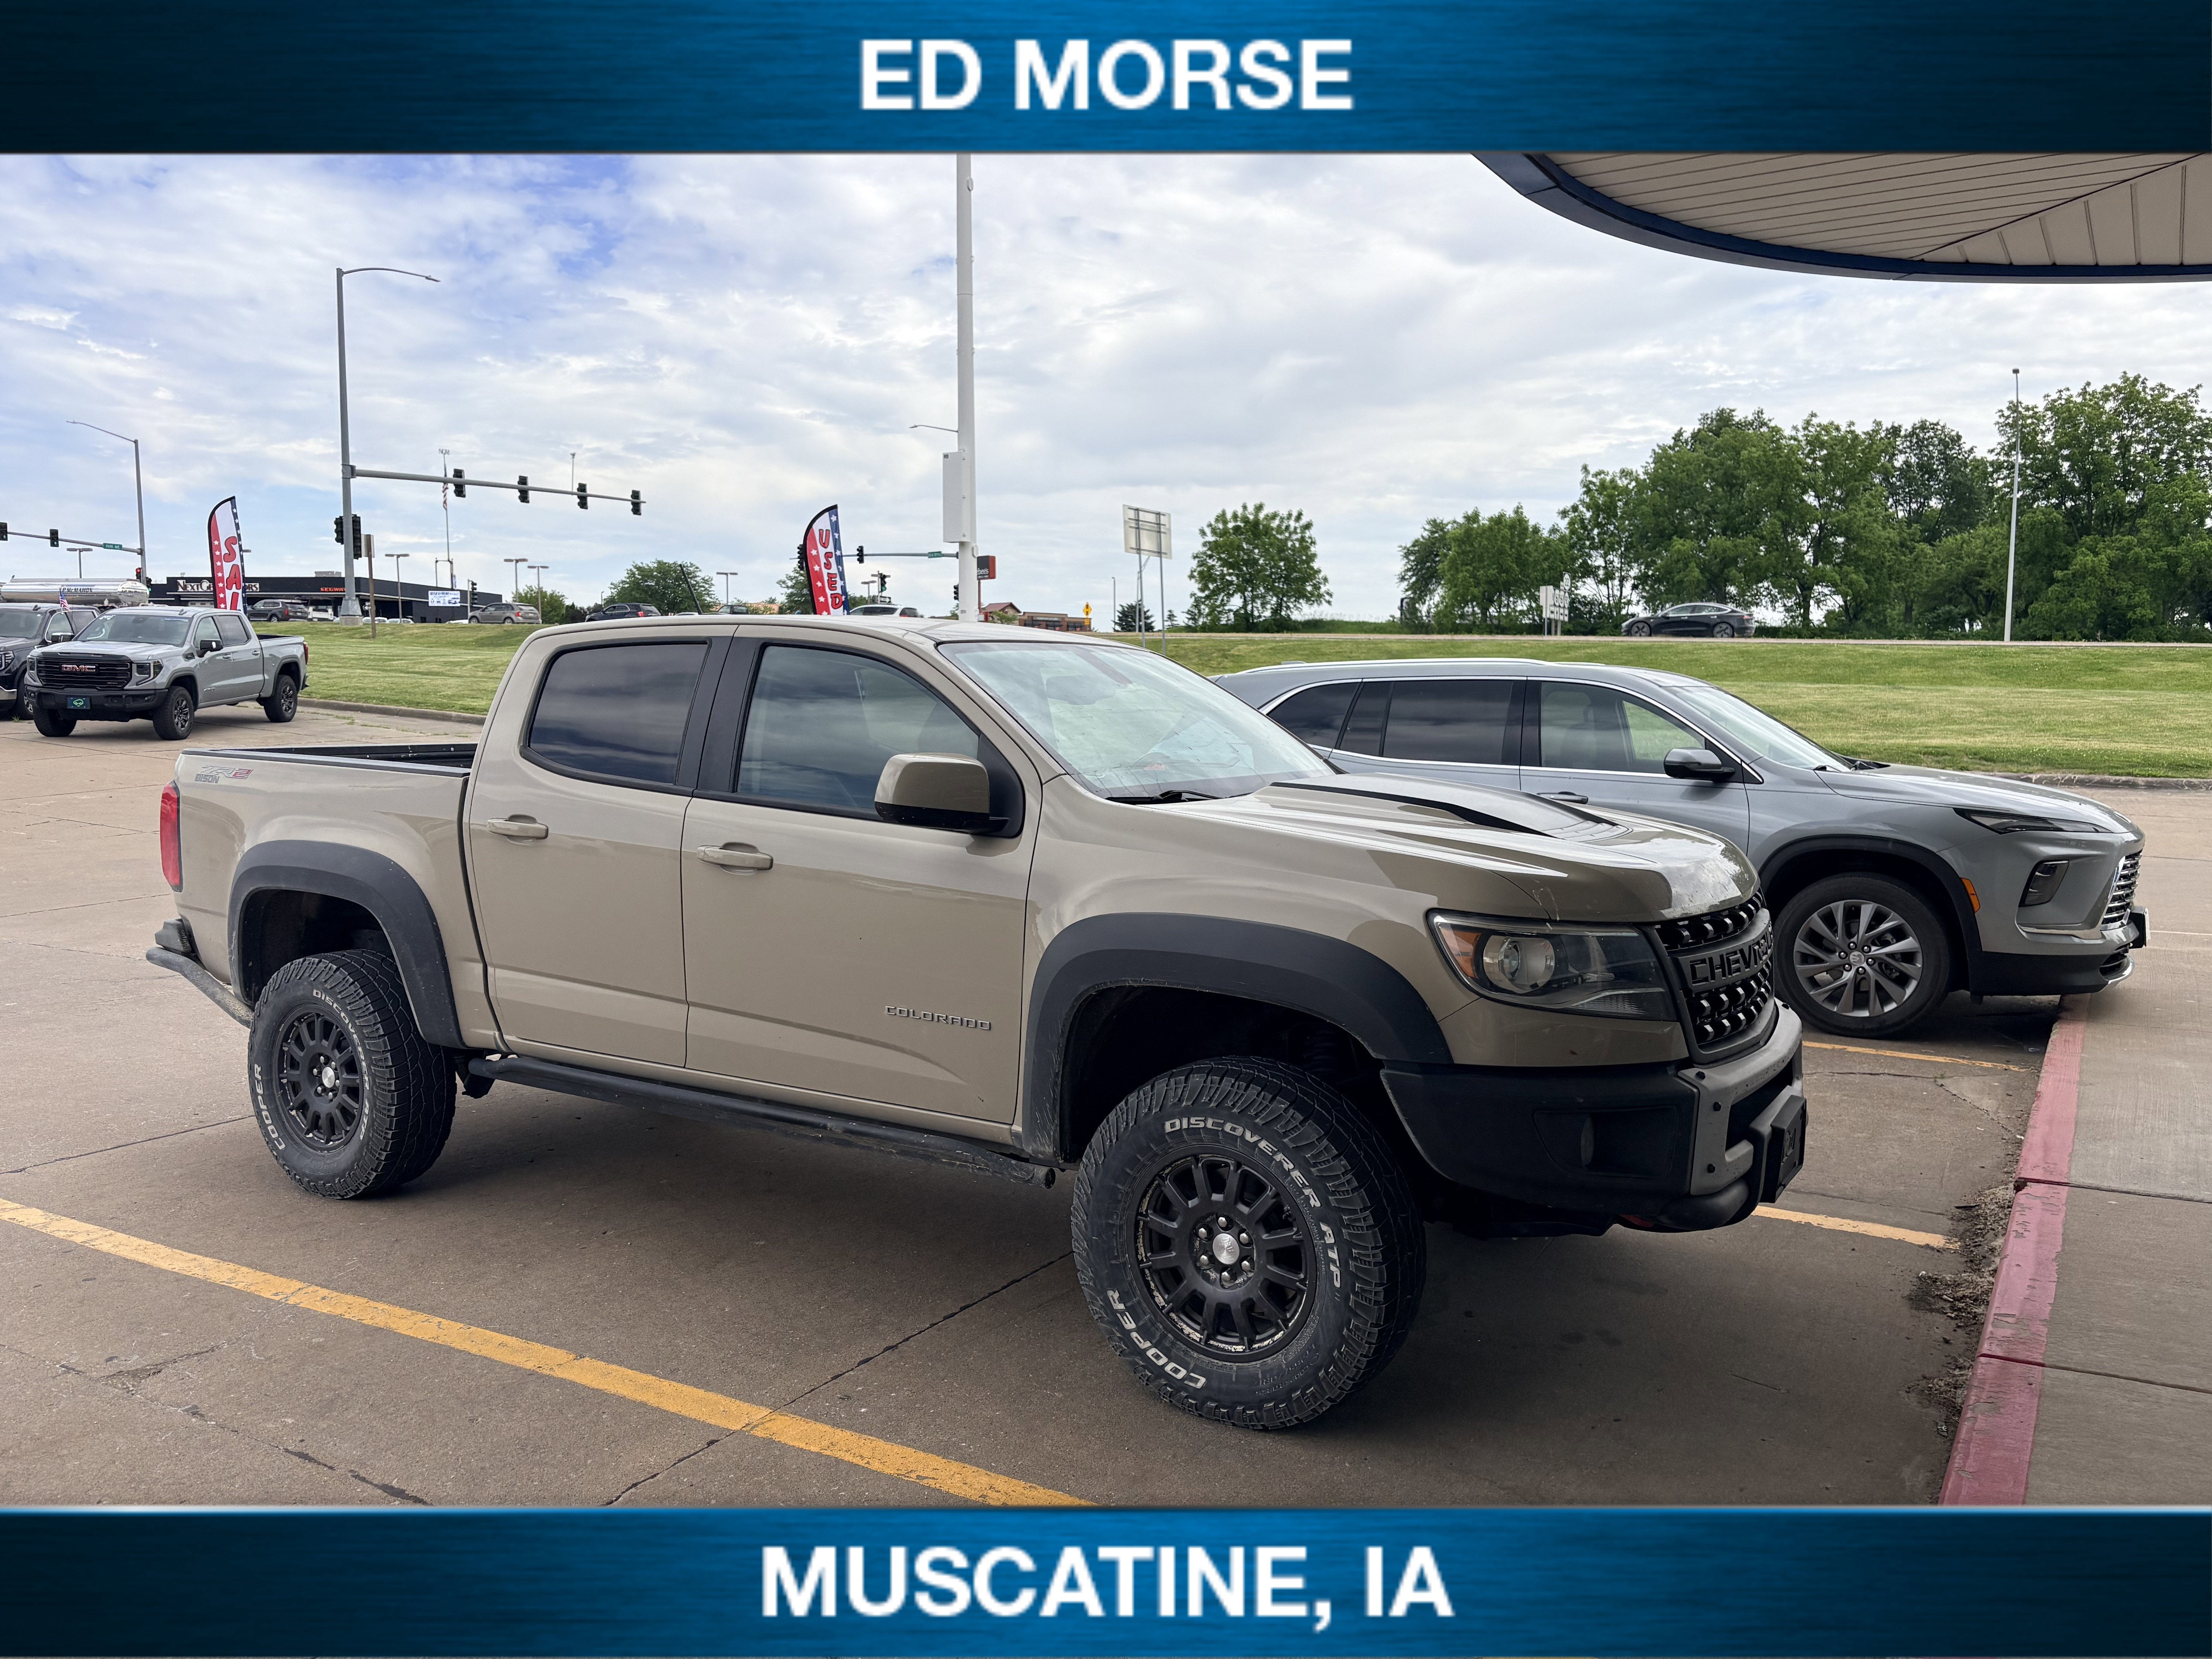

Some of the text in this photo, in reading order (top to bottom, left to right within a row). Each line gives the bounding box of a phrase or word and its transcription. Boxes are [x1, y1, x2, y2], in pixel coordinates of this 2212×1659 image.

[177, 579, 213, 591] NEXTGE
[223, 536, 241, 610] SAL
[818, 529, 843, 610] USED
[62, 664, 96, 672] GMC
[194, 773, 220, 784] BISON
[200, 765, 254, 779] ZR2
[313, 989, 369, 1090] DISCOVERER
[884, 1005, 991, 1030] COLORADO
[254, 1063, 286, 1150] COOPER
[1164, 1116, 1322, 1208] DISCOVERER
[1319, 1222, 1341, 1288] ATP
[1107, 1289, 1207, 1390] COOPER
